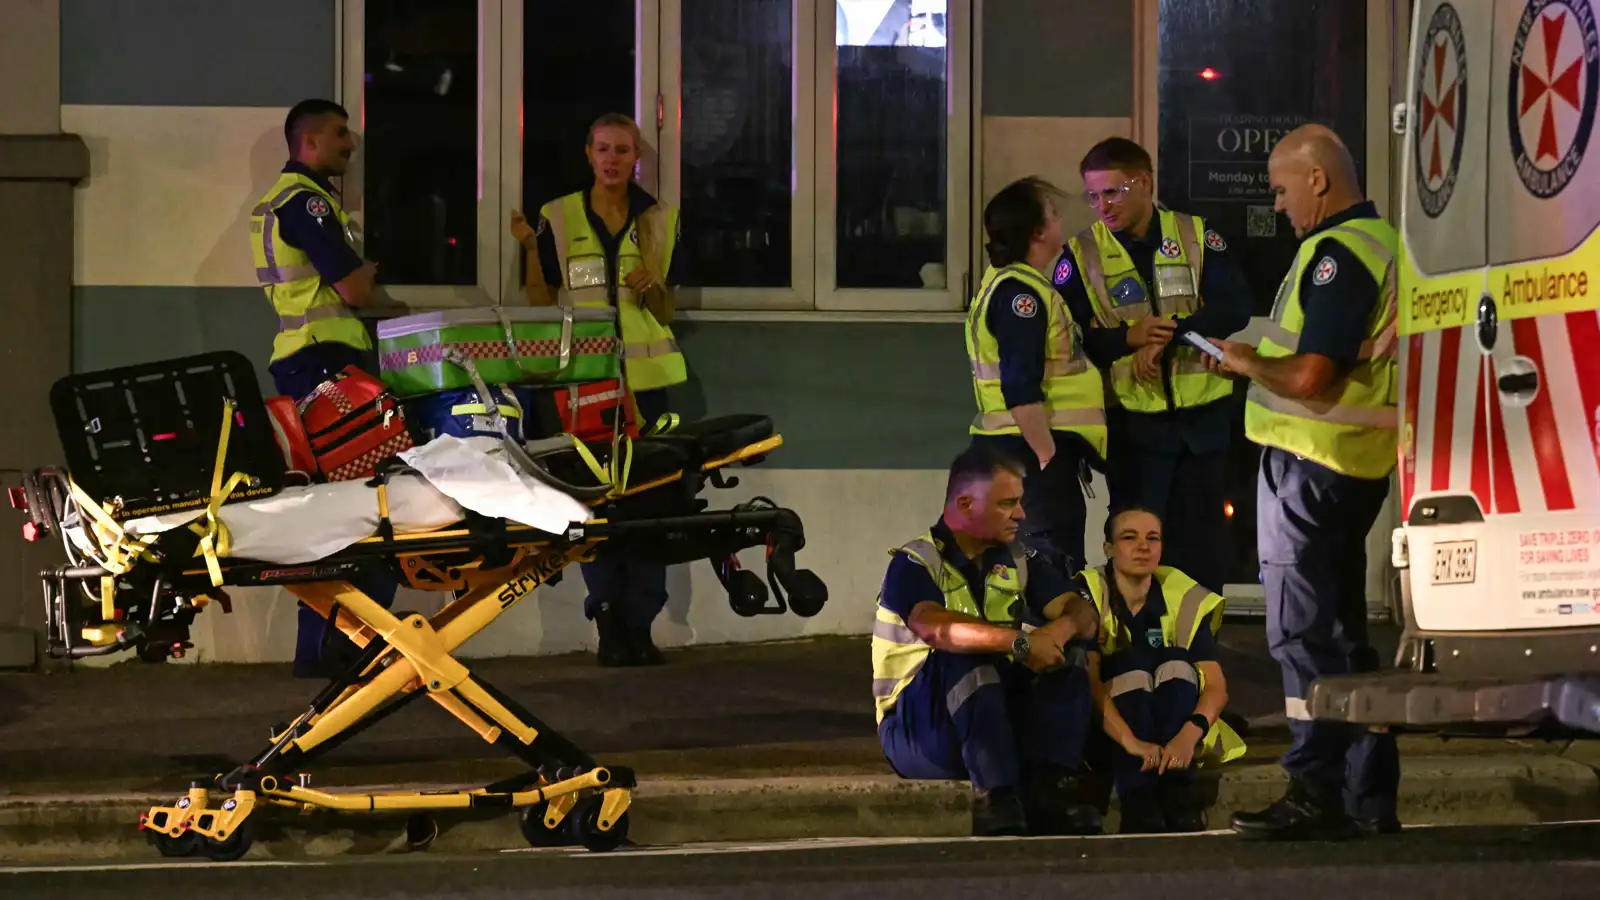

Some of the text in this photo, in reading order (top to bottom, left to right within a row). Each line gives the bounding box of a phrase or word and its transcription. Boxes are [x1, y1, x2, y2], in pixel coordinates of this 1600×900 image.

[1217, 128, 1289, 152] OPE
[1209, 171, 1255, 185] Monday
[1411, 268, 1588, 325] Emergency Ambulance
[172, 497, 201, 509] manual
[247, 487, 273, 497] device
[498, 551, 569, 609] stryker
